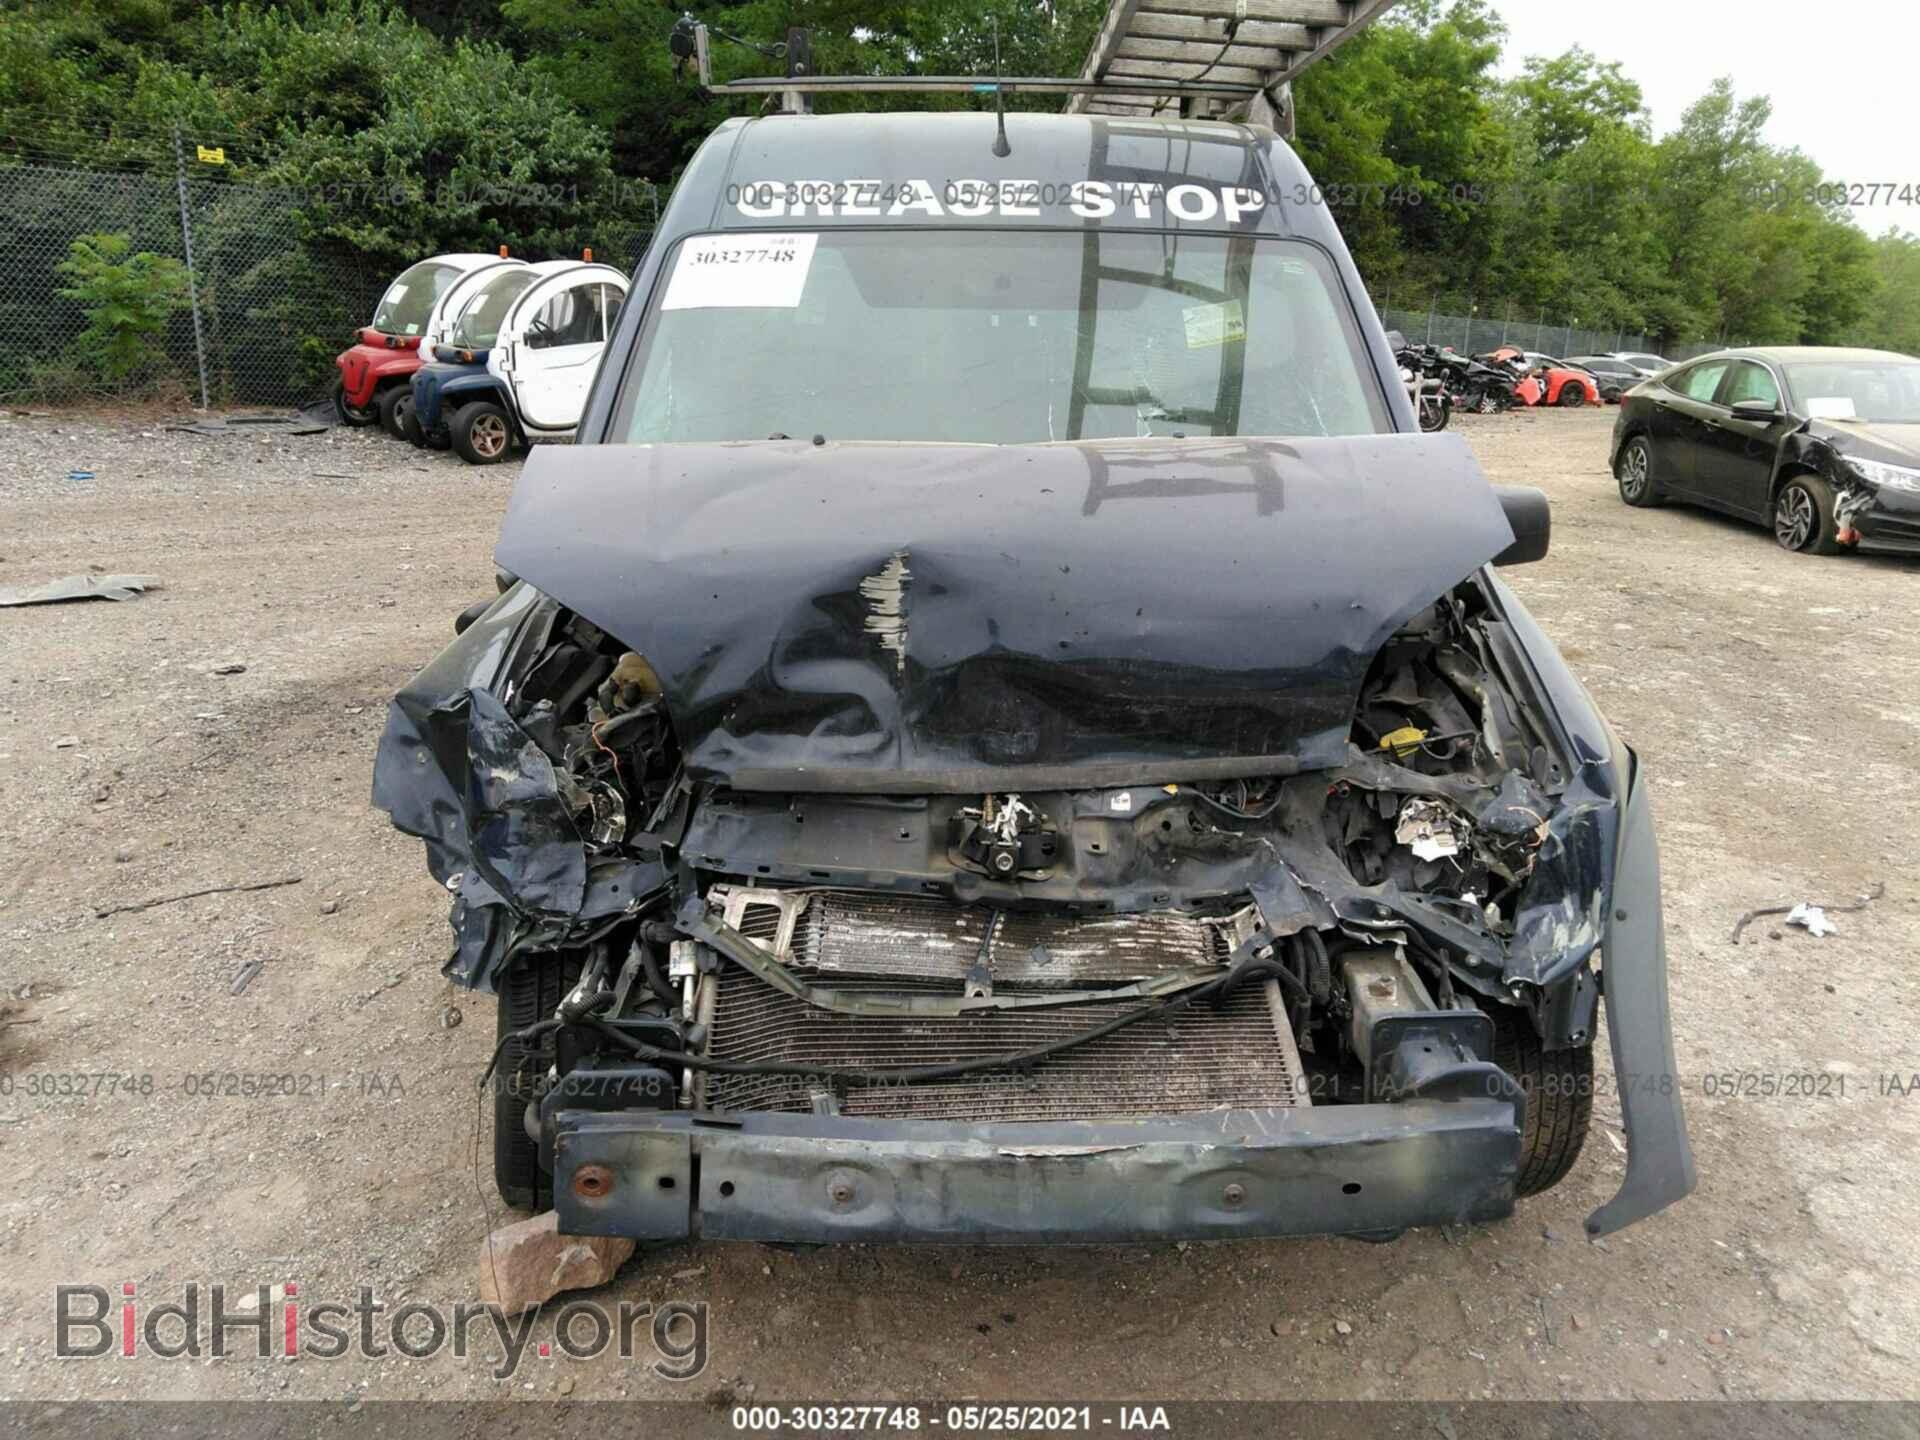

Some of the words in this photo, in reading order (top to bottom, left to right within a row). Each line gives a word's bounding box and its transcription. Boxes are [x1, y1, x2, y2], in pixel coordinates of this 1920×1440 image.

[736, 179, 1041, 218] GREASE
[1070, 180, 1265, 223] STOP
[696, 249, 796, 264] 30327748
